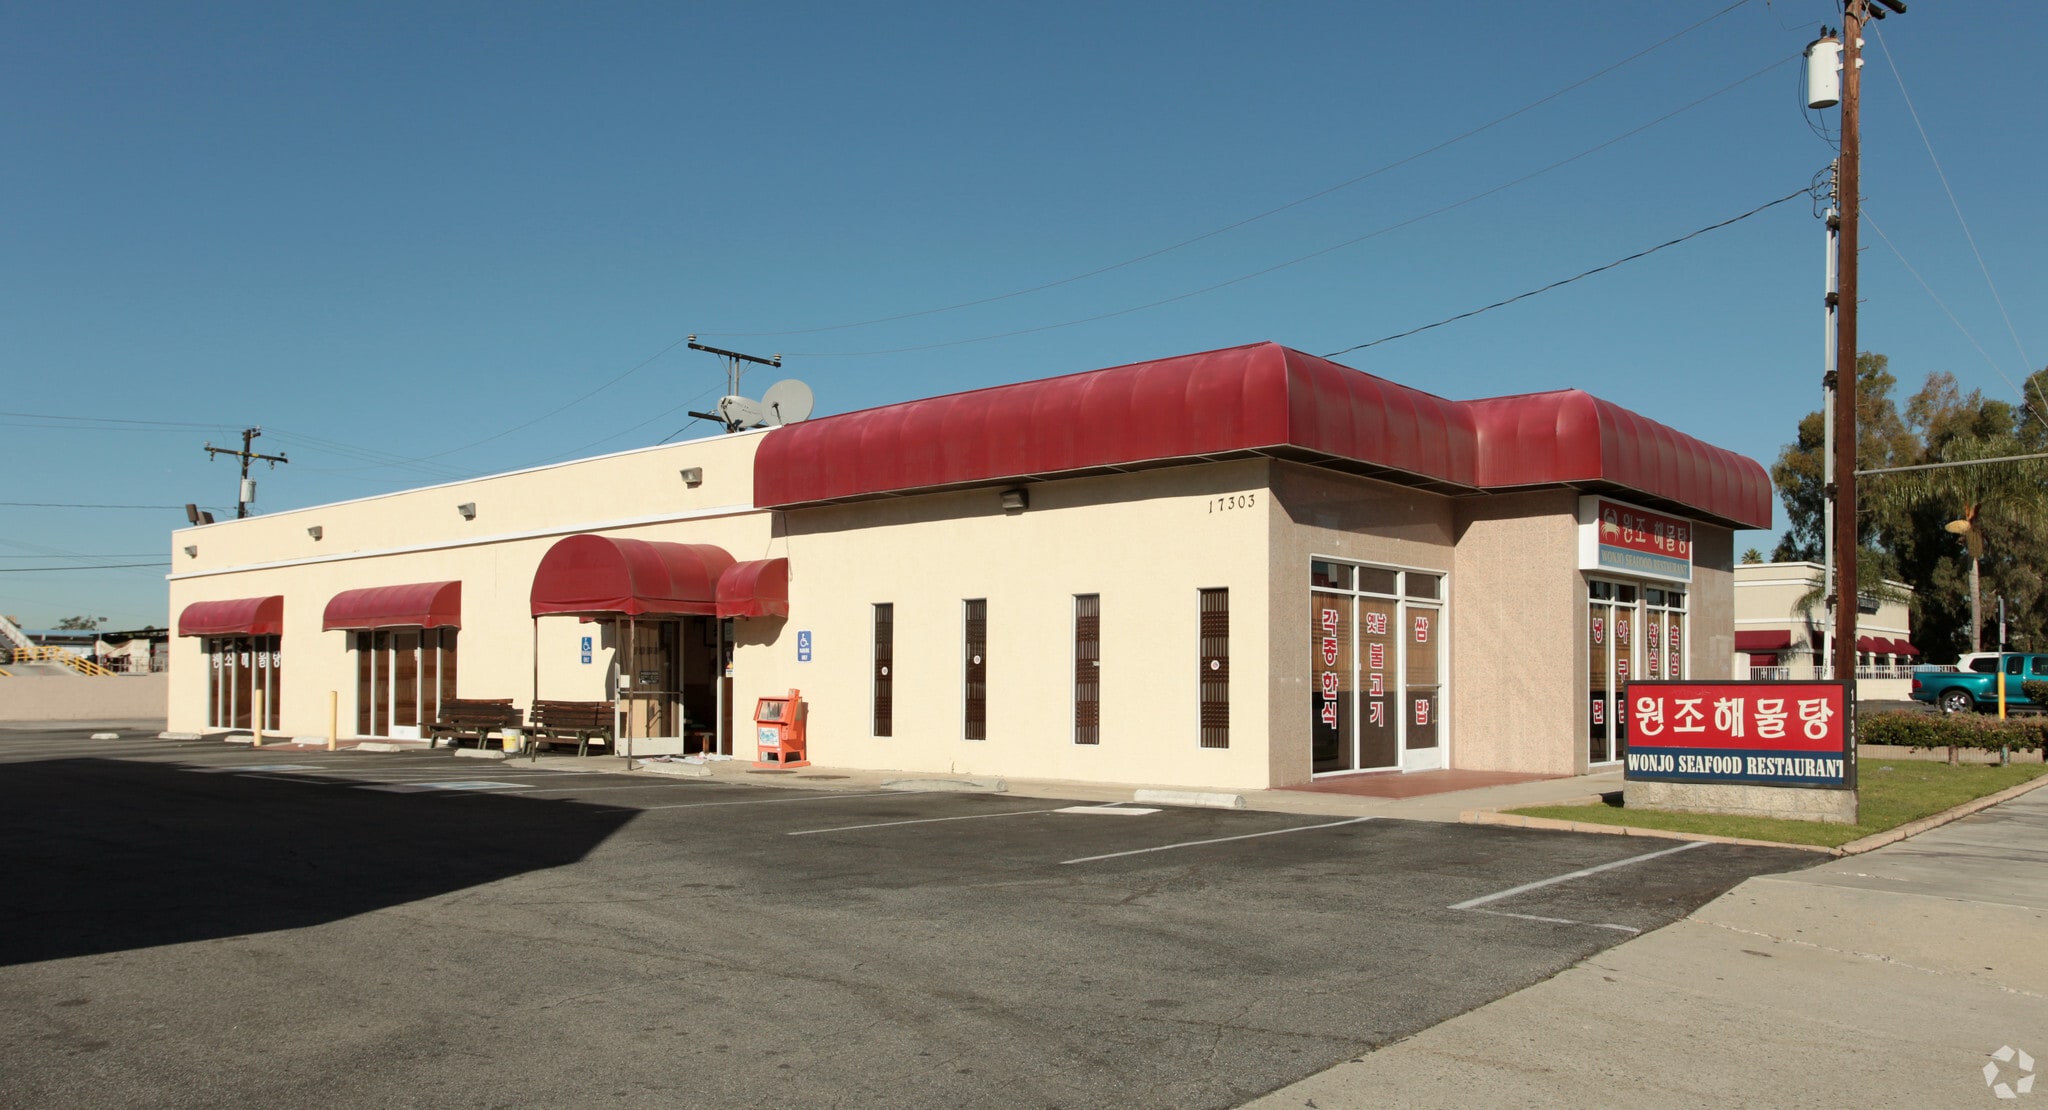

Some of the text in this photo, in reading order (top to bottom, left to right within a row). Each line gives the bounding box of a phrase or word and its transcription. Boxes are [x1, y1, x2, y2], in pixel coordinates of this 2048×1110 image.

[1209, 494, 1255, 514] 17303
[1623, 513, 1687, 555] 원조 해물탕
[1601, 549, 1624, 566] WONJO
[1625, 554, 1653, 570] SEAFOOD
[1366, 612, 1386, 635] 옛날
[1649, 622, 1659, 680] 황실
[1369, 642, 1383, 728] 불고기
[1628, 754, 1844, 778] WONJO SEAFOOD RESTAURANT
